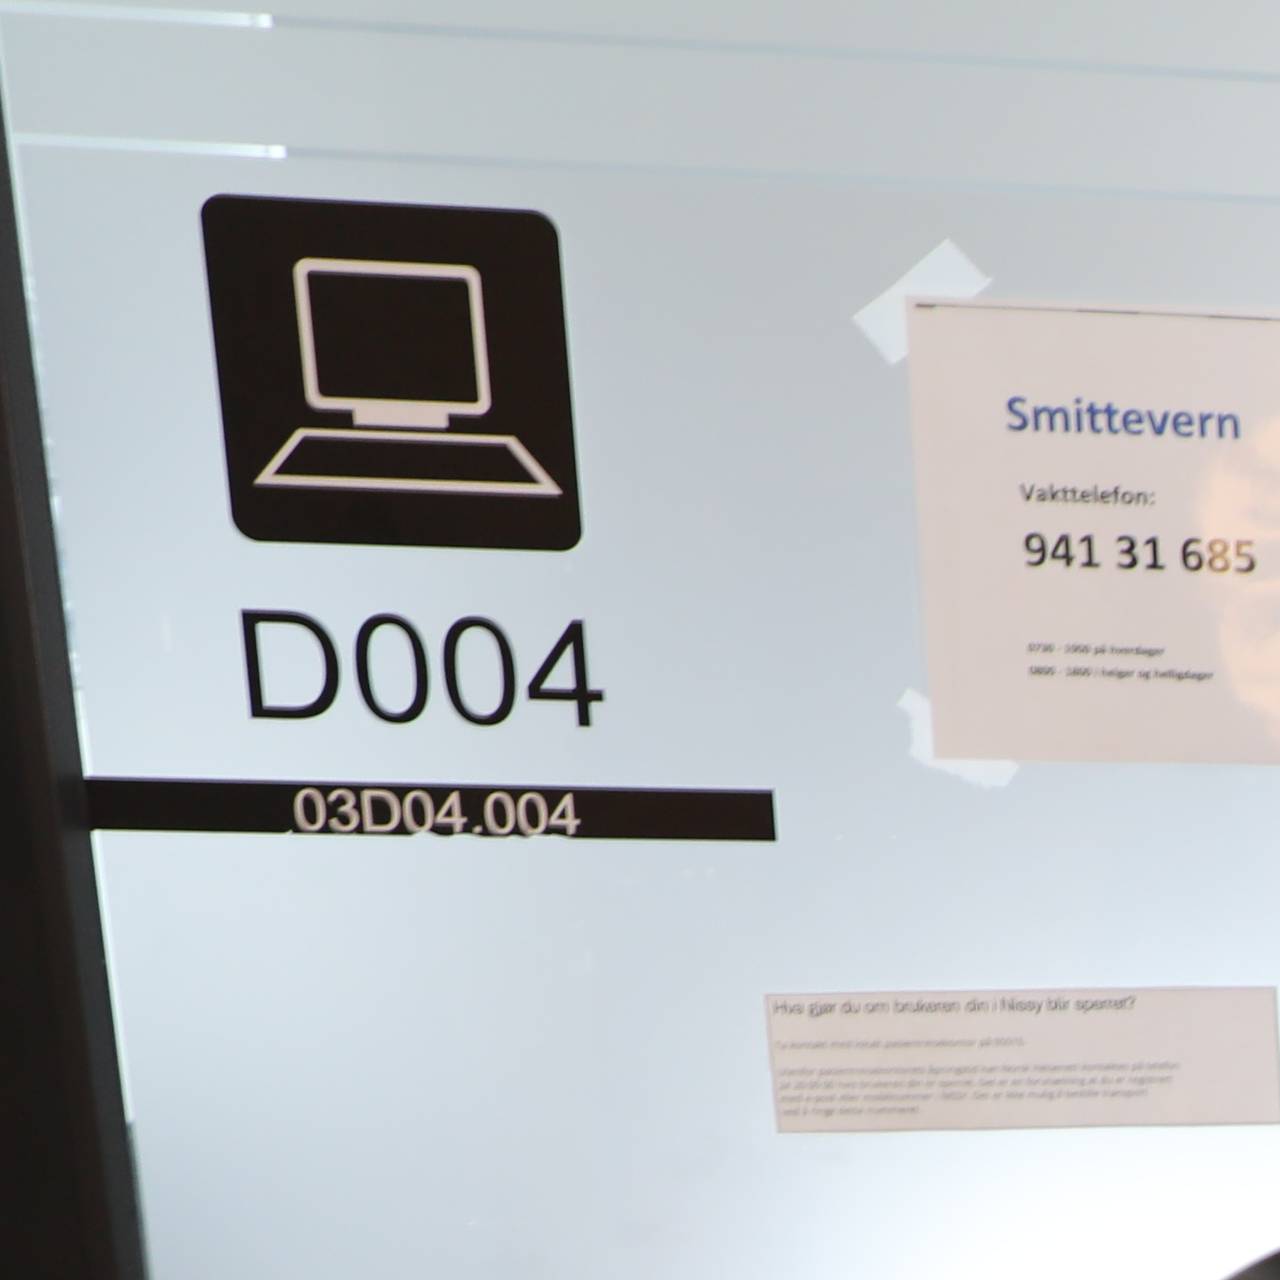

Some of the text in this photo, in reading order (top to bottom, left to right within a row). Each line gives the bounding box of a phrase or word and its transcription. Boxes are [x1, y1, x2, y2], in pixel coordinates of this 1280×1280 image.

[1006, 396, 1241, 440] Smittevern
[1019, 483, 1156, 507] Vakttelefon:
[1024, 532, 1257, 575] 941 31 685
[241, 609, 605, 728] D004
[293, 786, 581, 837] 03D04.004
